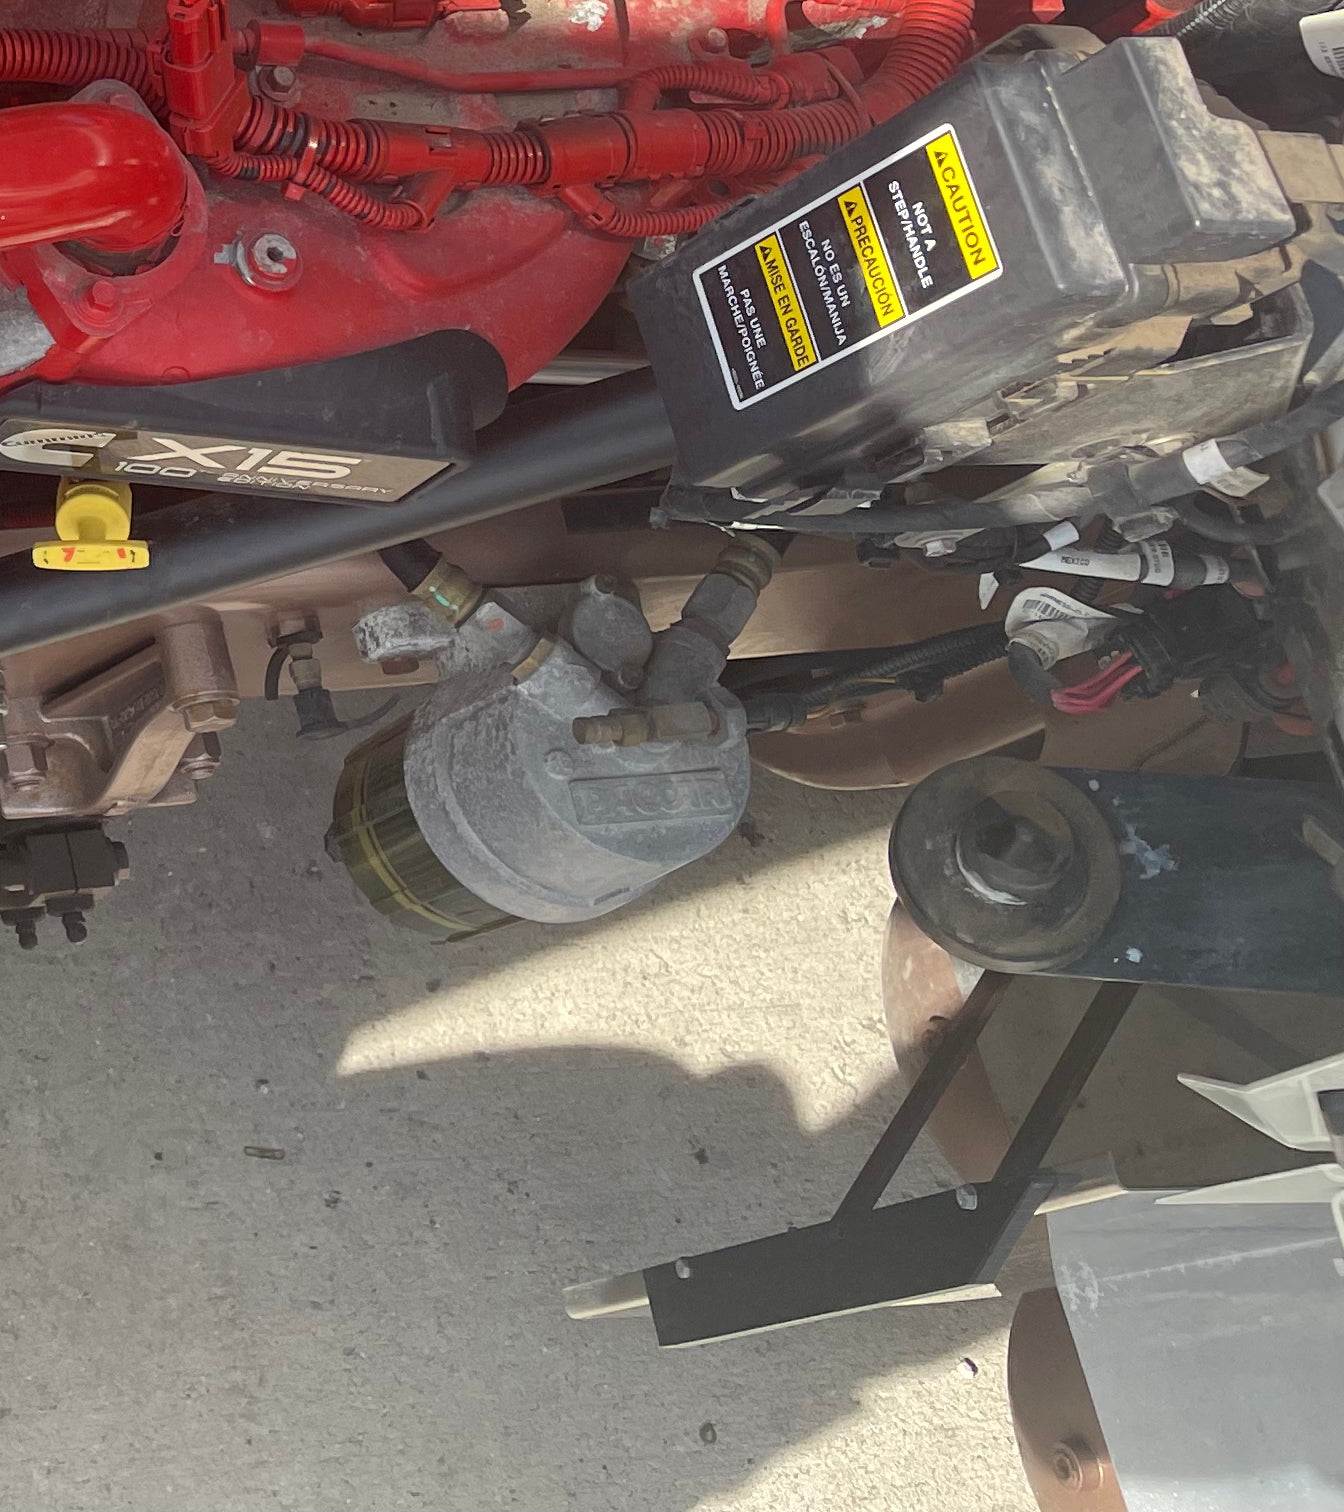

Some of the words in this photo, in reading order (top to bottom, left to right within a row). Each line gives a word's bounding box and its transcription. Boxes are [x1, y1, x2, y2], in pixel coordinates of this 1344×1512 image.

[889, 179, 934, 290] STEP/HANDLE
[912, 201, 933, 237] NOT
[924, 238, 938, 252] A
[941, 166, 987, 266] CAUTION
[764, 260, 787, 292] MISE
[777, 293, 793, 316] EN
[785, 316, 811, 366] GARDE
[798, 220, 848, 347] ESCALÓN/MANIJA
[820, 238, 838, 263] NO
[829, 262, 843, 285] ES
[837, 286, 851, 309] UN
[852, 217, 896, 317] PRECAUCIÓN
[717, 264, 767, 390] MARCHE/POIGNÉE
[740, 288, 755, 314] PAS
[749, 316, 768, 349] UNE
[126, 437, 364, 480] X15
[1060, 555, 1090, 567] MEXICO
